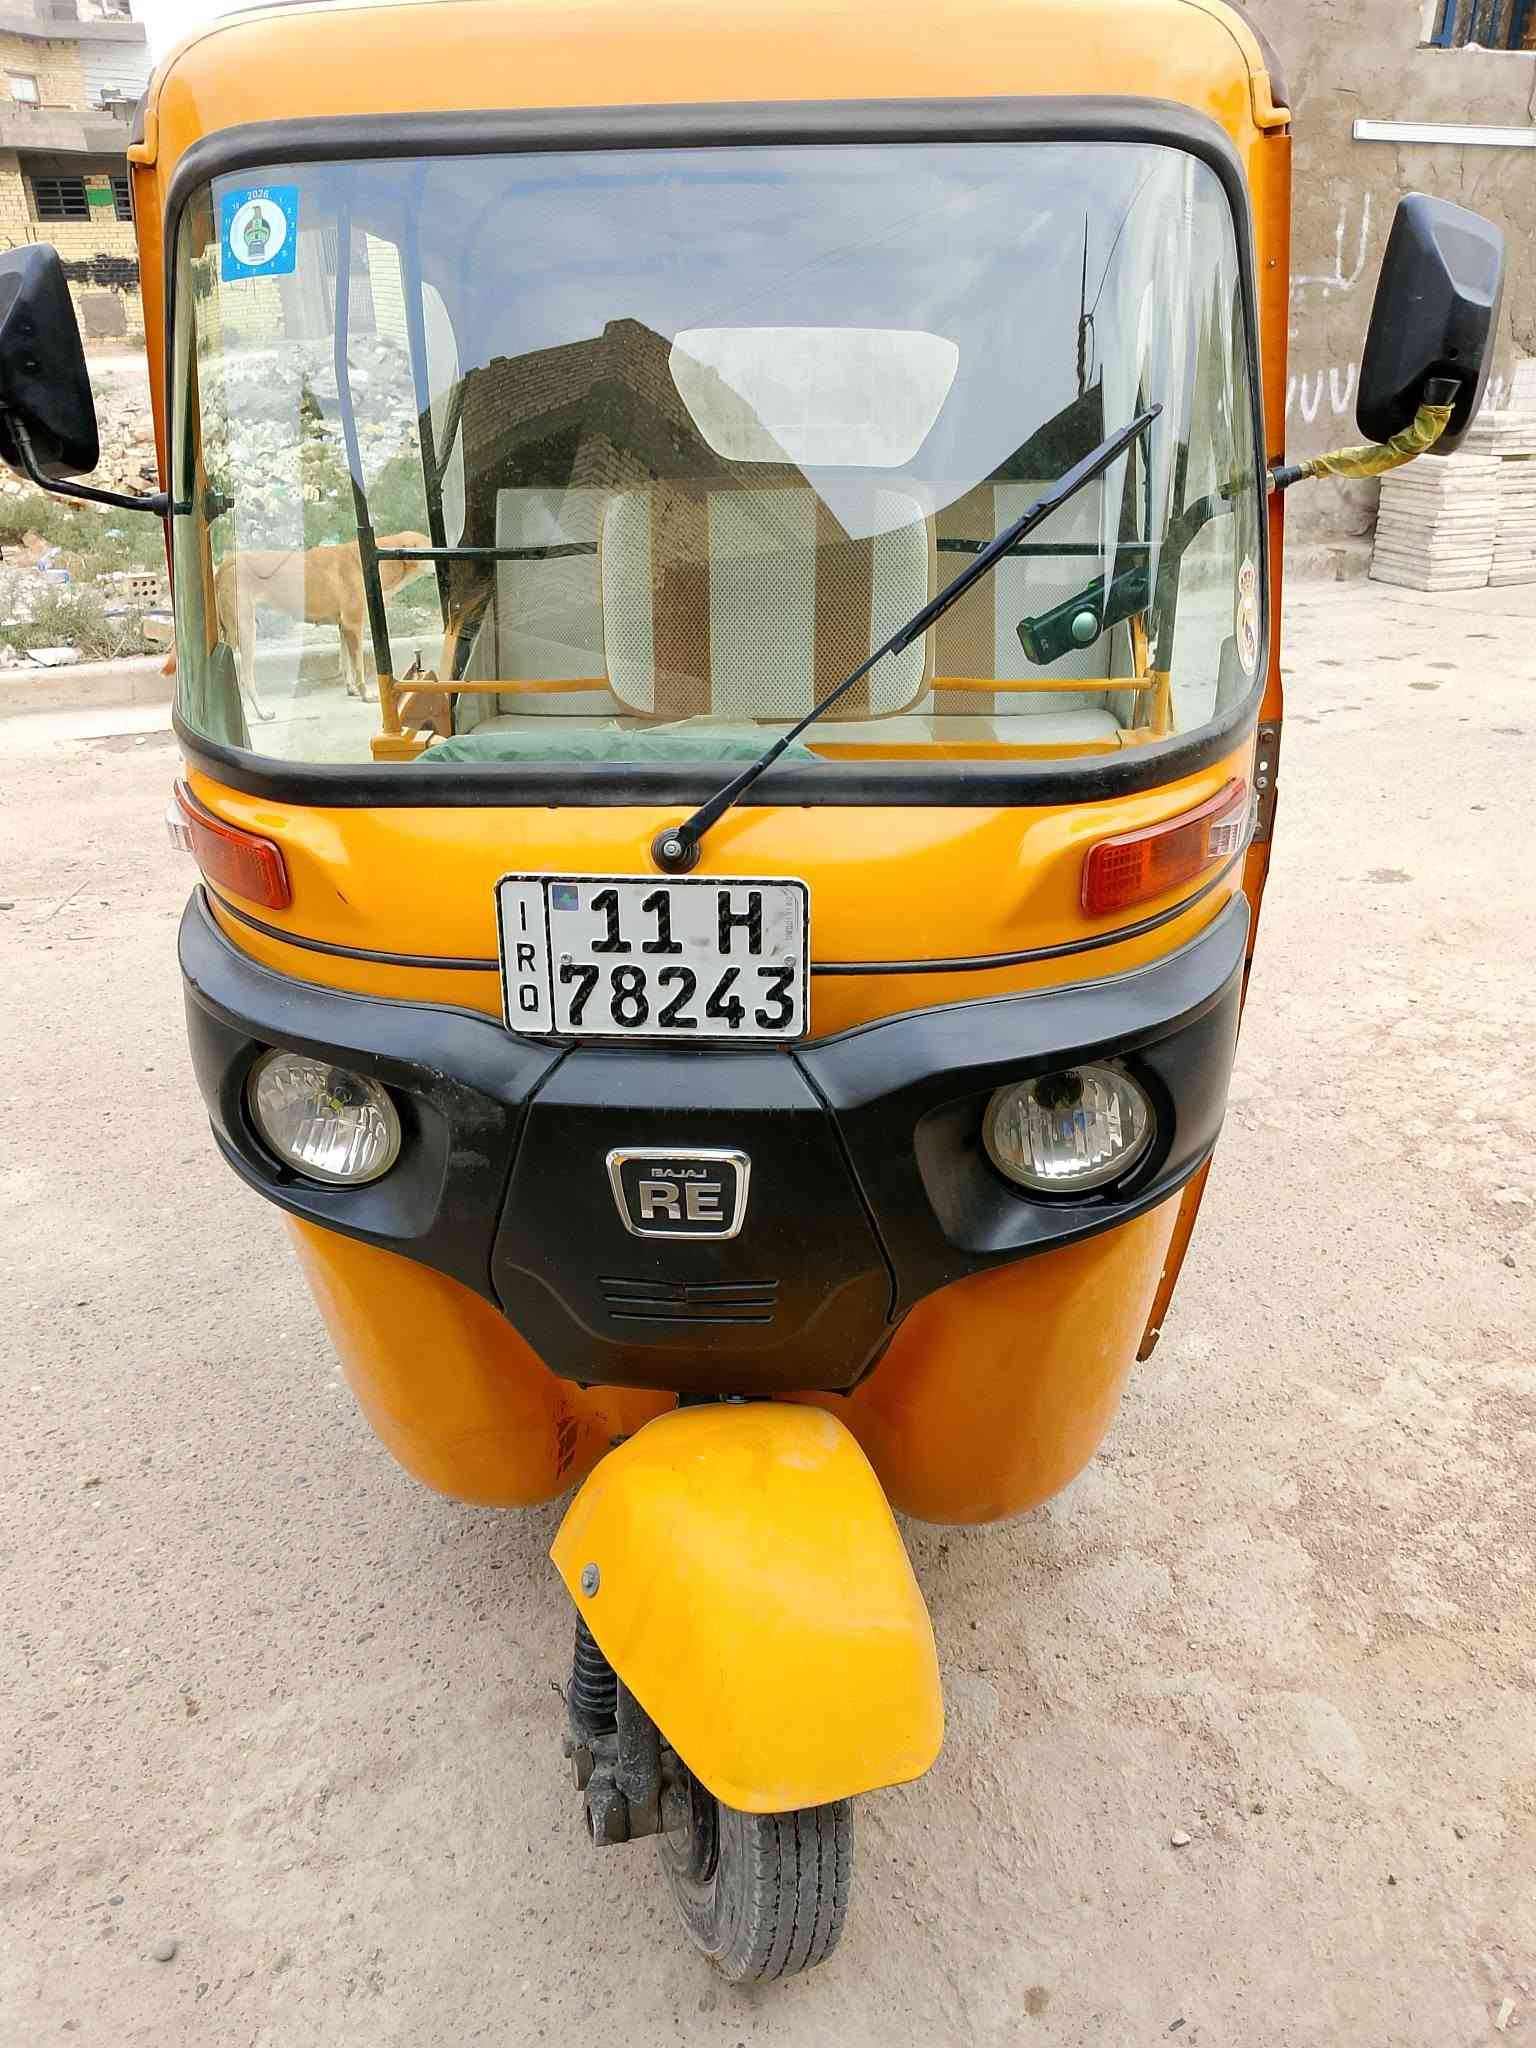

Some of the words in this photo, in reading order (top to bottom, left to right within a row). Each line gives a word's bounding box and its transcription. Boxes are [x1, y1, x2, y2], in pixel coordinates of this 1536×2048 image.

[247, 188, 270, 200] 2026
[591, 889, 683, 954] 11
[717, 890, 762, 955] H
[516, 900, 539, 1012] IRQ
[559, 963, 795, 1030] 78243
[651, 1167, 707, 1178] BAJAJ
[639, 1180, 724, 1221] RE
